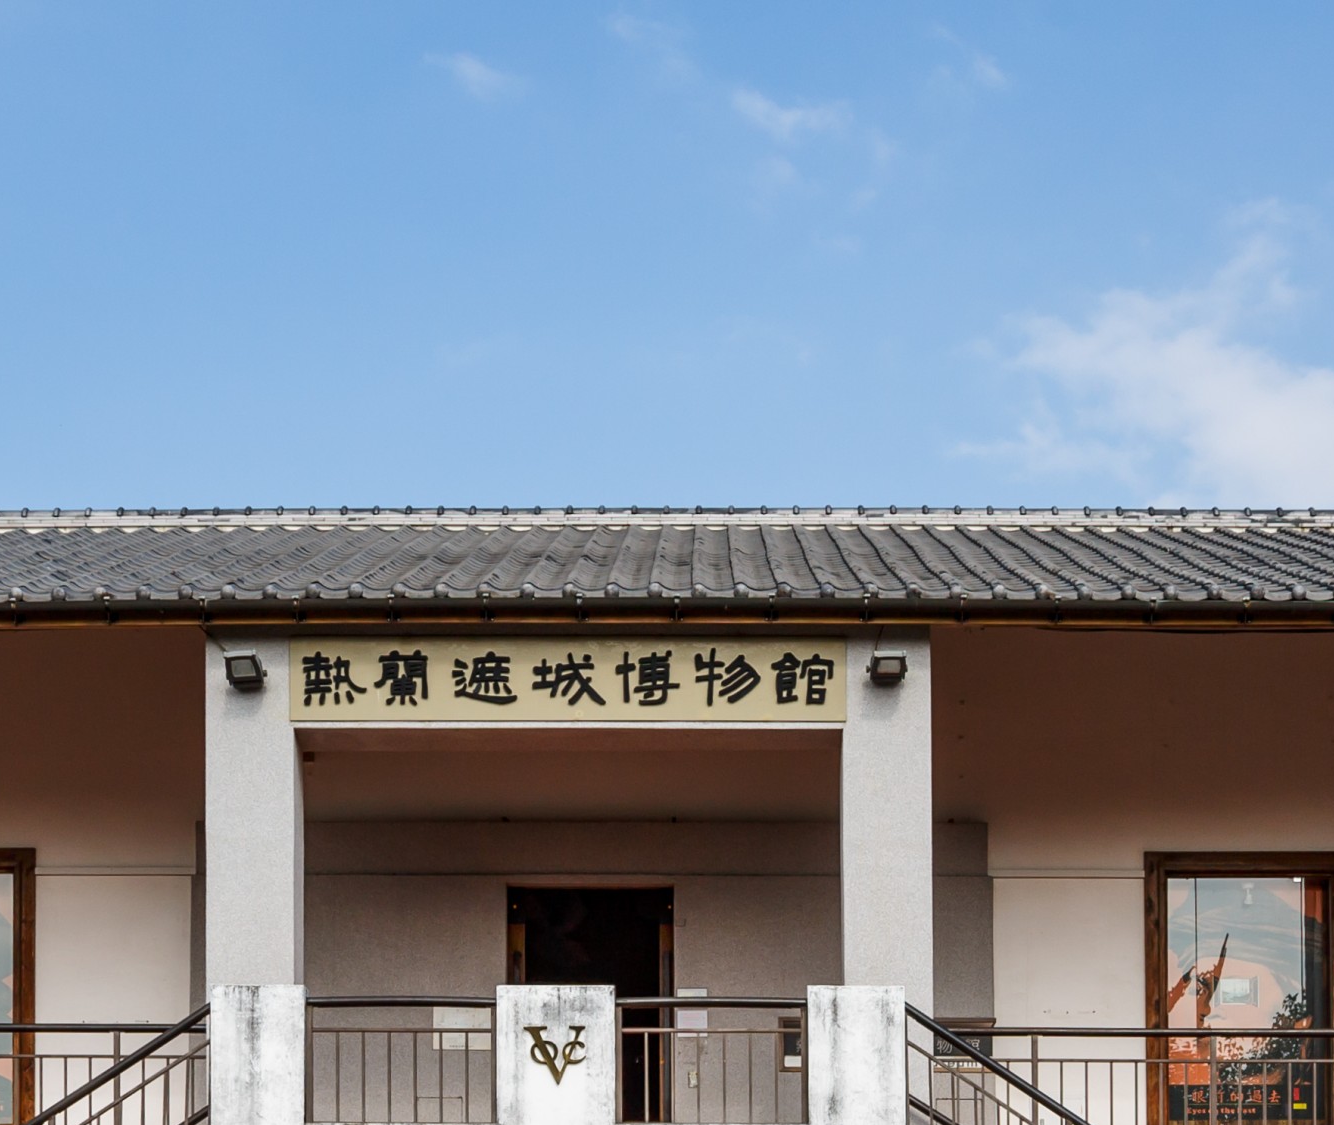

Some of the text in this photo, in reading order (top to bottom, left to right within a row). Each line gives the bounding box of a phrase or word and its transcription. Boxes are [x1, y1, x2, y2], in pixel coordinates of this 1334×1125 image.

[302, 648, 835, 706] 熱蘭遮城博物館
